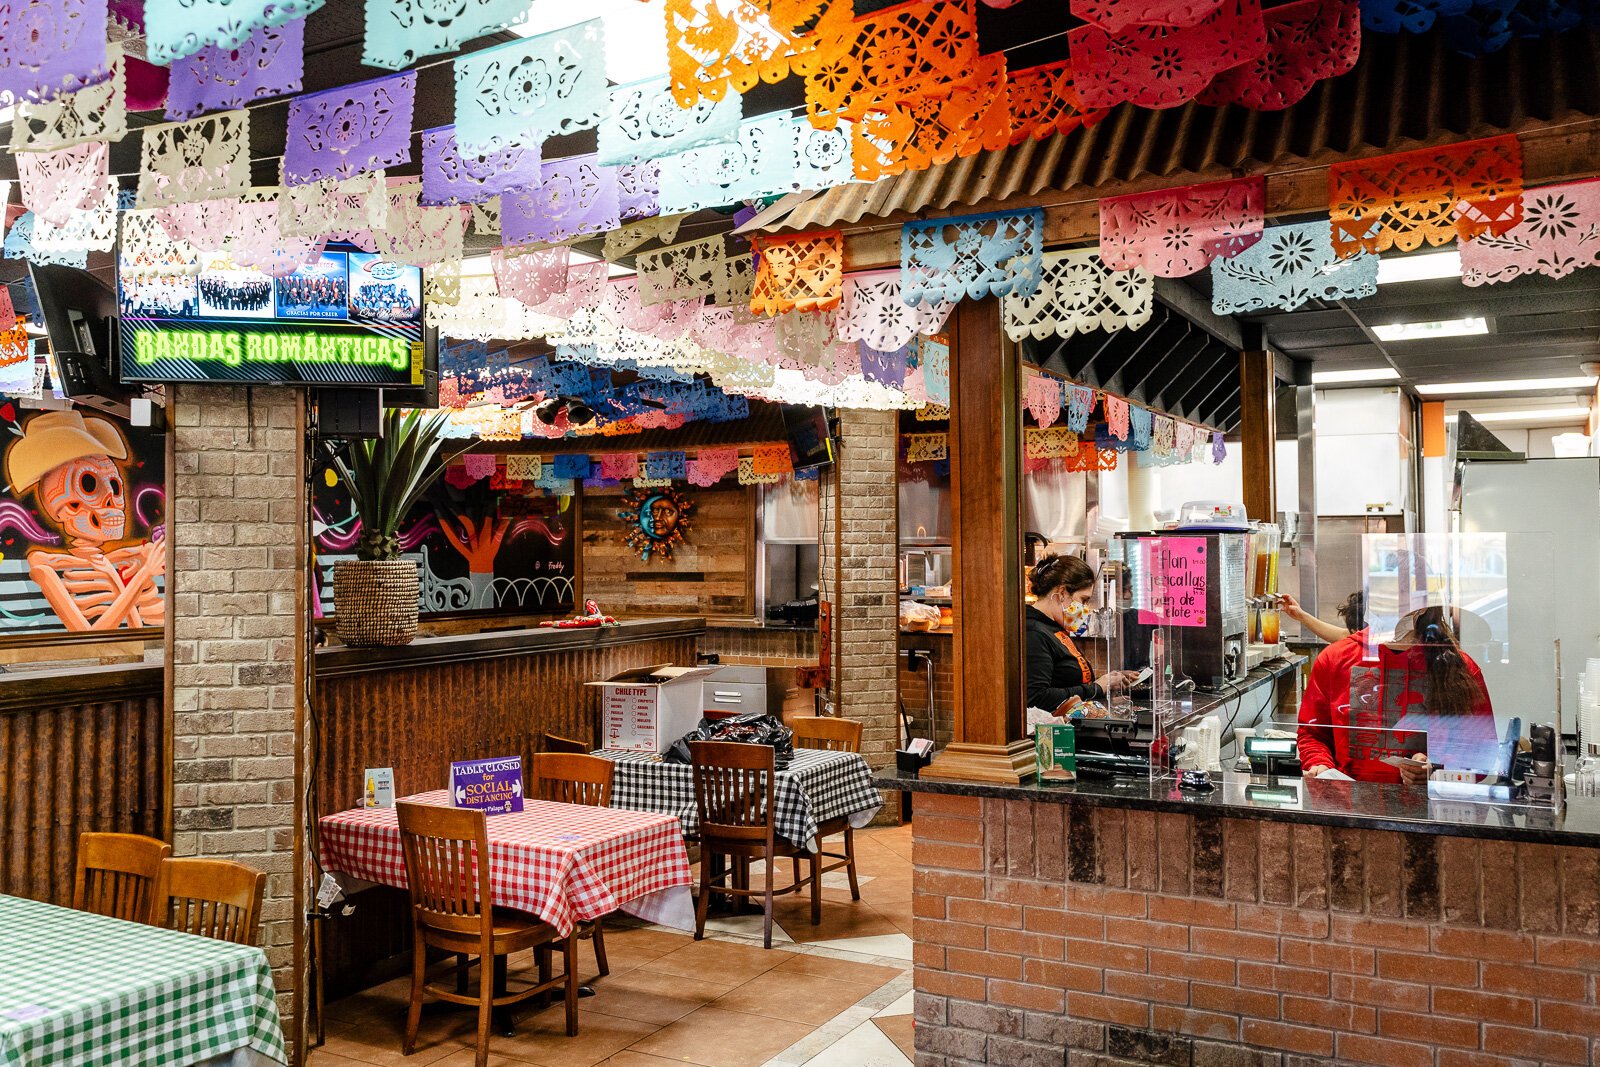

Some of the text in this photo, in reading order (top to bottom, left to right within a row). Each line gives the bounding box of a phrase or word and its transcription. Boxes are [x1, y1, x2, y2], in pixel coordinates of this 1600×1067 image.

[137, 331, 240, 365] BANDAS
[247, 332, 406, 368] ROMÁNTICAS
[549, 561, 564, 573] Freddy
[1151, 592, 1194, 610] pan de
[1166, 607, 1190, 618] elote
[454, 762, 519, 775] TABLE CLOSED
[466, 781, 512, 795] SOCIAL
[466, 792, 513, 804] DISTANCING
